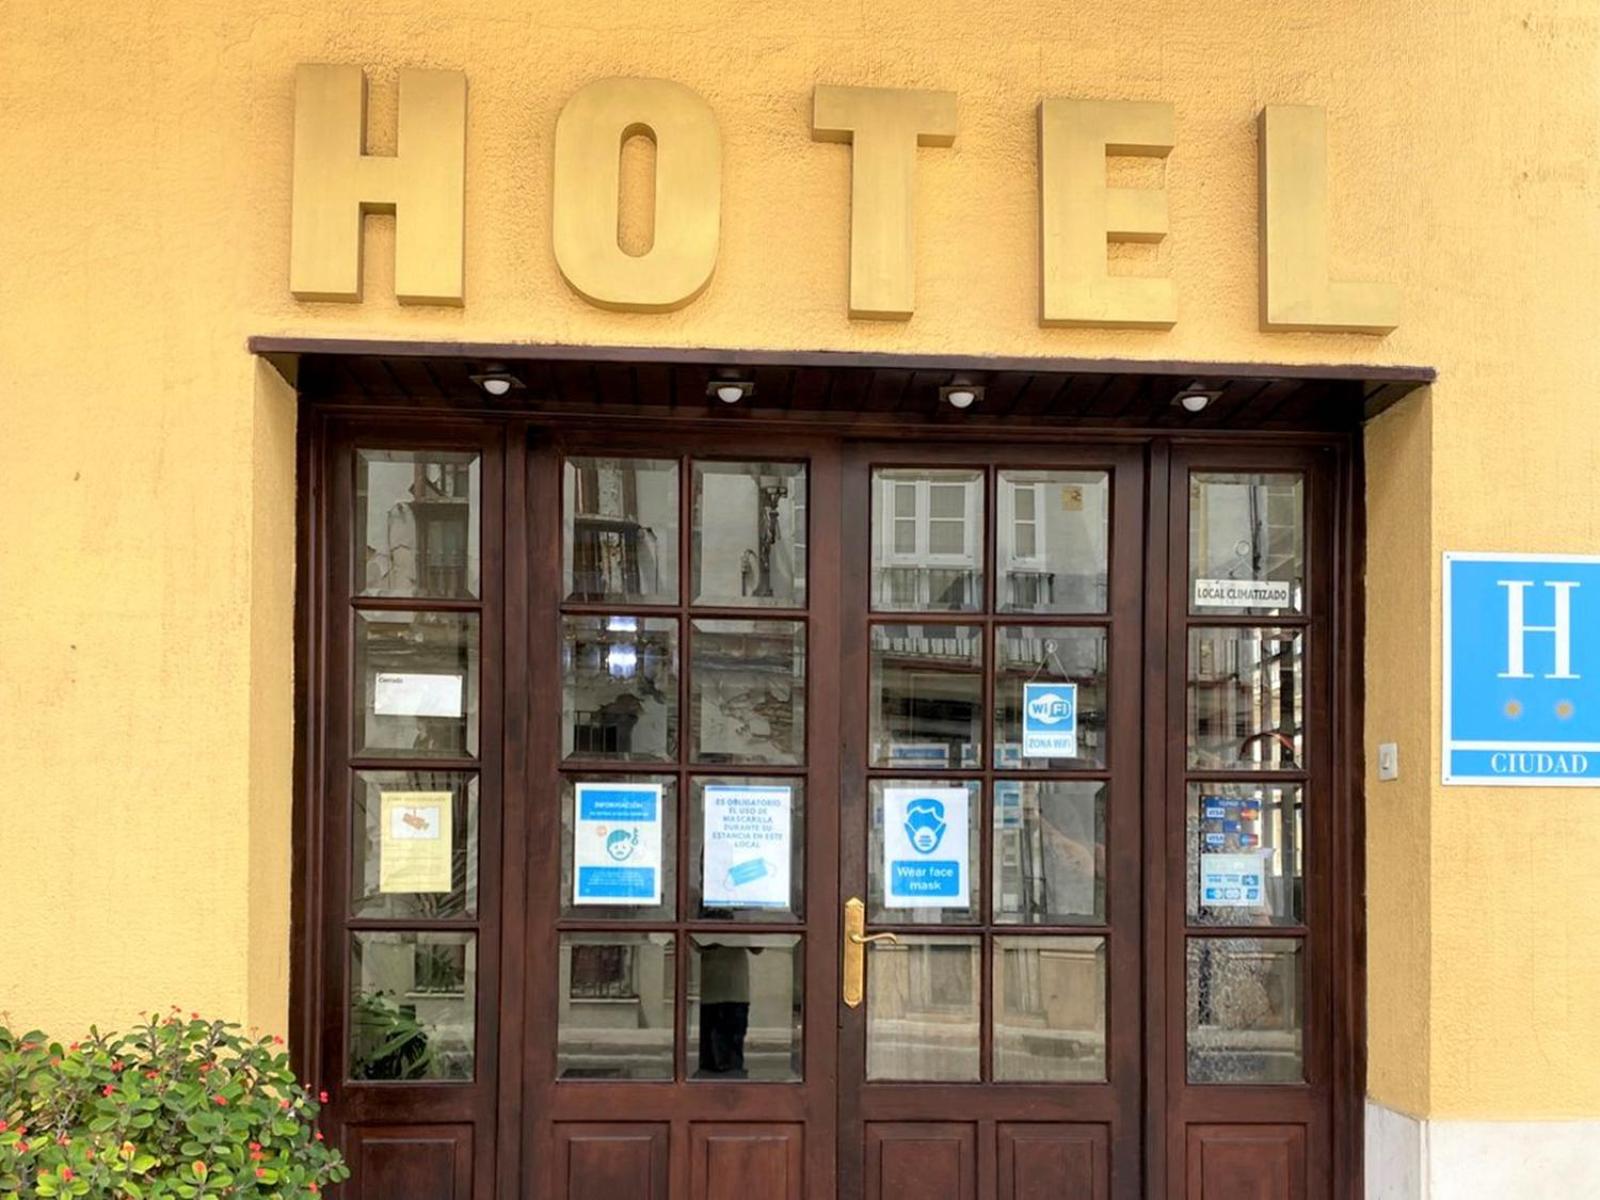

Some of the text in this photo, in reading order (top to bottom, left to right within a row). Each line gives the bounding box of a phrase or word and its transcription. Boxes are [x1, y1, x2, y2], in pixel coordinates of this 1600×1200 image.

[289, 63, 1400, 335] HOTEL
[1197, 588, 1287, 601] LOCAL CLIMATIZADO
[1496, 579, 1581, 679] H
[1029, 738, 1052, 748] ZONA
[1490, 752, 1588, 774] CIUDAD
[715, 798, 781, 807] ES OBLIGATORIO
[739, 807, 756, 815] USO
[758, 807, 767, 815] DE
[723, 815, 773, 823] MASCARILLA
[712, 832, 751, 840] ESTANCIA
[765, 832, 783, 840] ESTE
[896, 866, 954, 878] Wear face
[909, 881, 942, 890] mask
